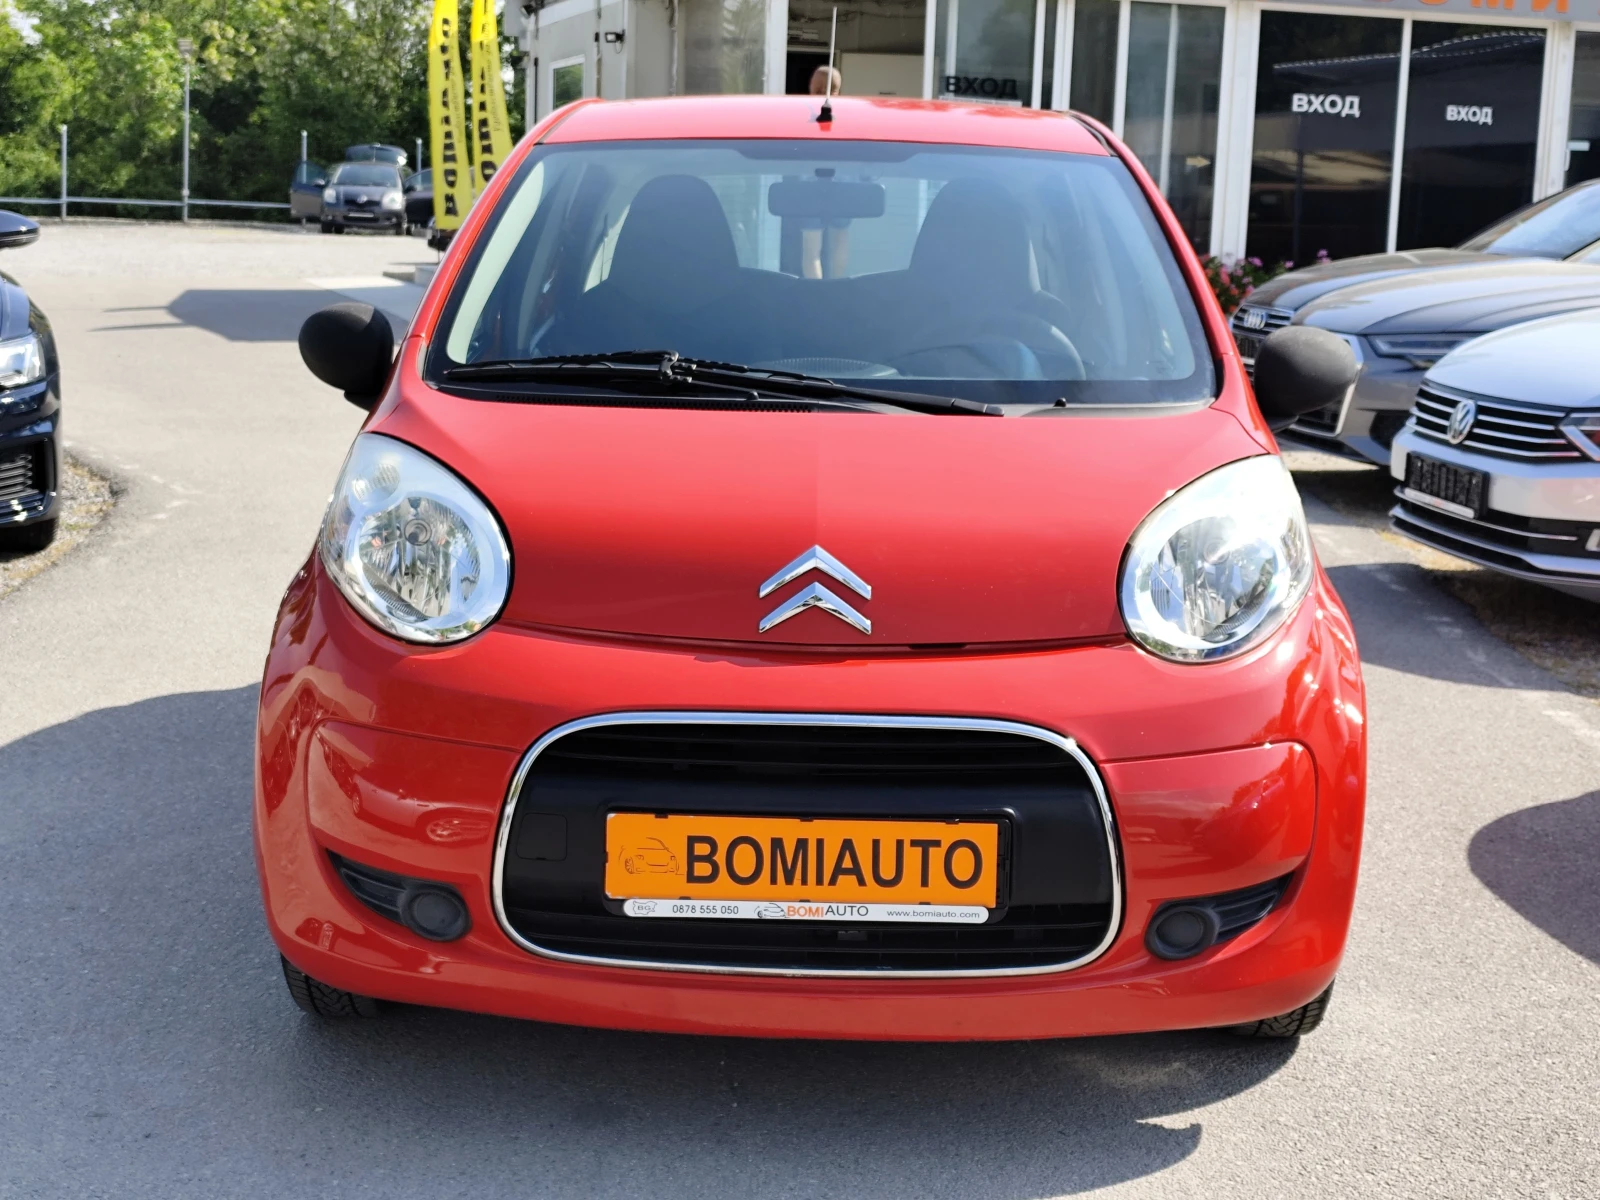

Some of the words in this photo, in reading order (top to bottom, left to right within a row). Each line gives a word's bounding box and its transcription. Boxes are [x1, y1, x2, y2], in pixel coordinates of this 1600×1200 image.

[946, 76, 1018, 98] ВХОД
[1292, 92, 1361, 118] ВХОД
[1446, 104, 1493, 125] ВХОД
[686, 835, 983, 888] BOMIAUTO
[672, 904, 697, 914] 0878
[700, 905, 718, 915] 555
[721, 905, 739, 915] 050
[886, 909, 980, 919] www.bomiauto.com
